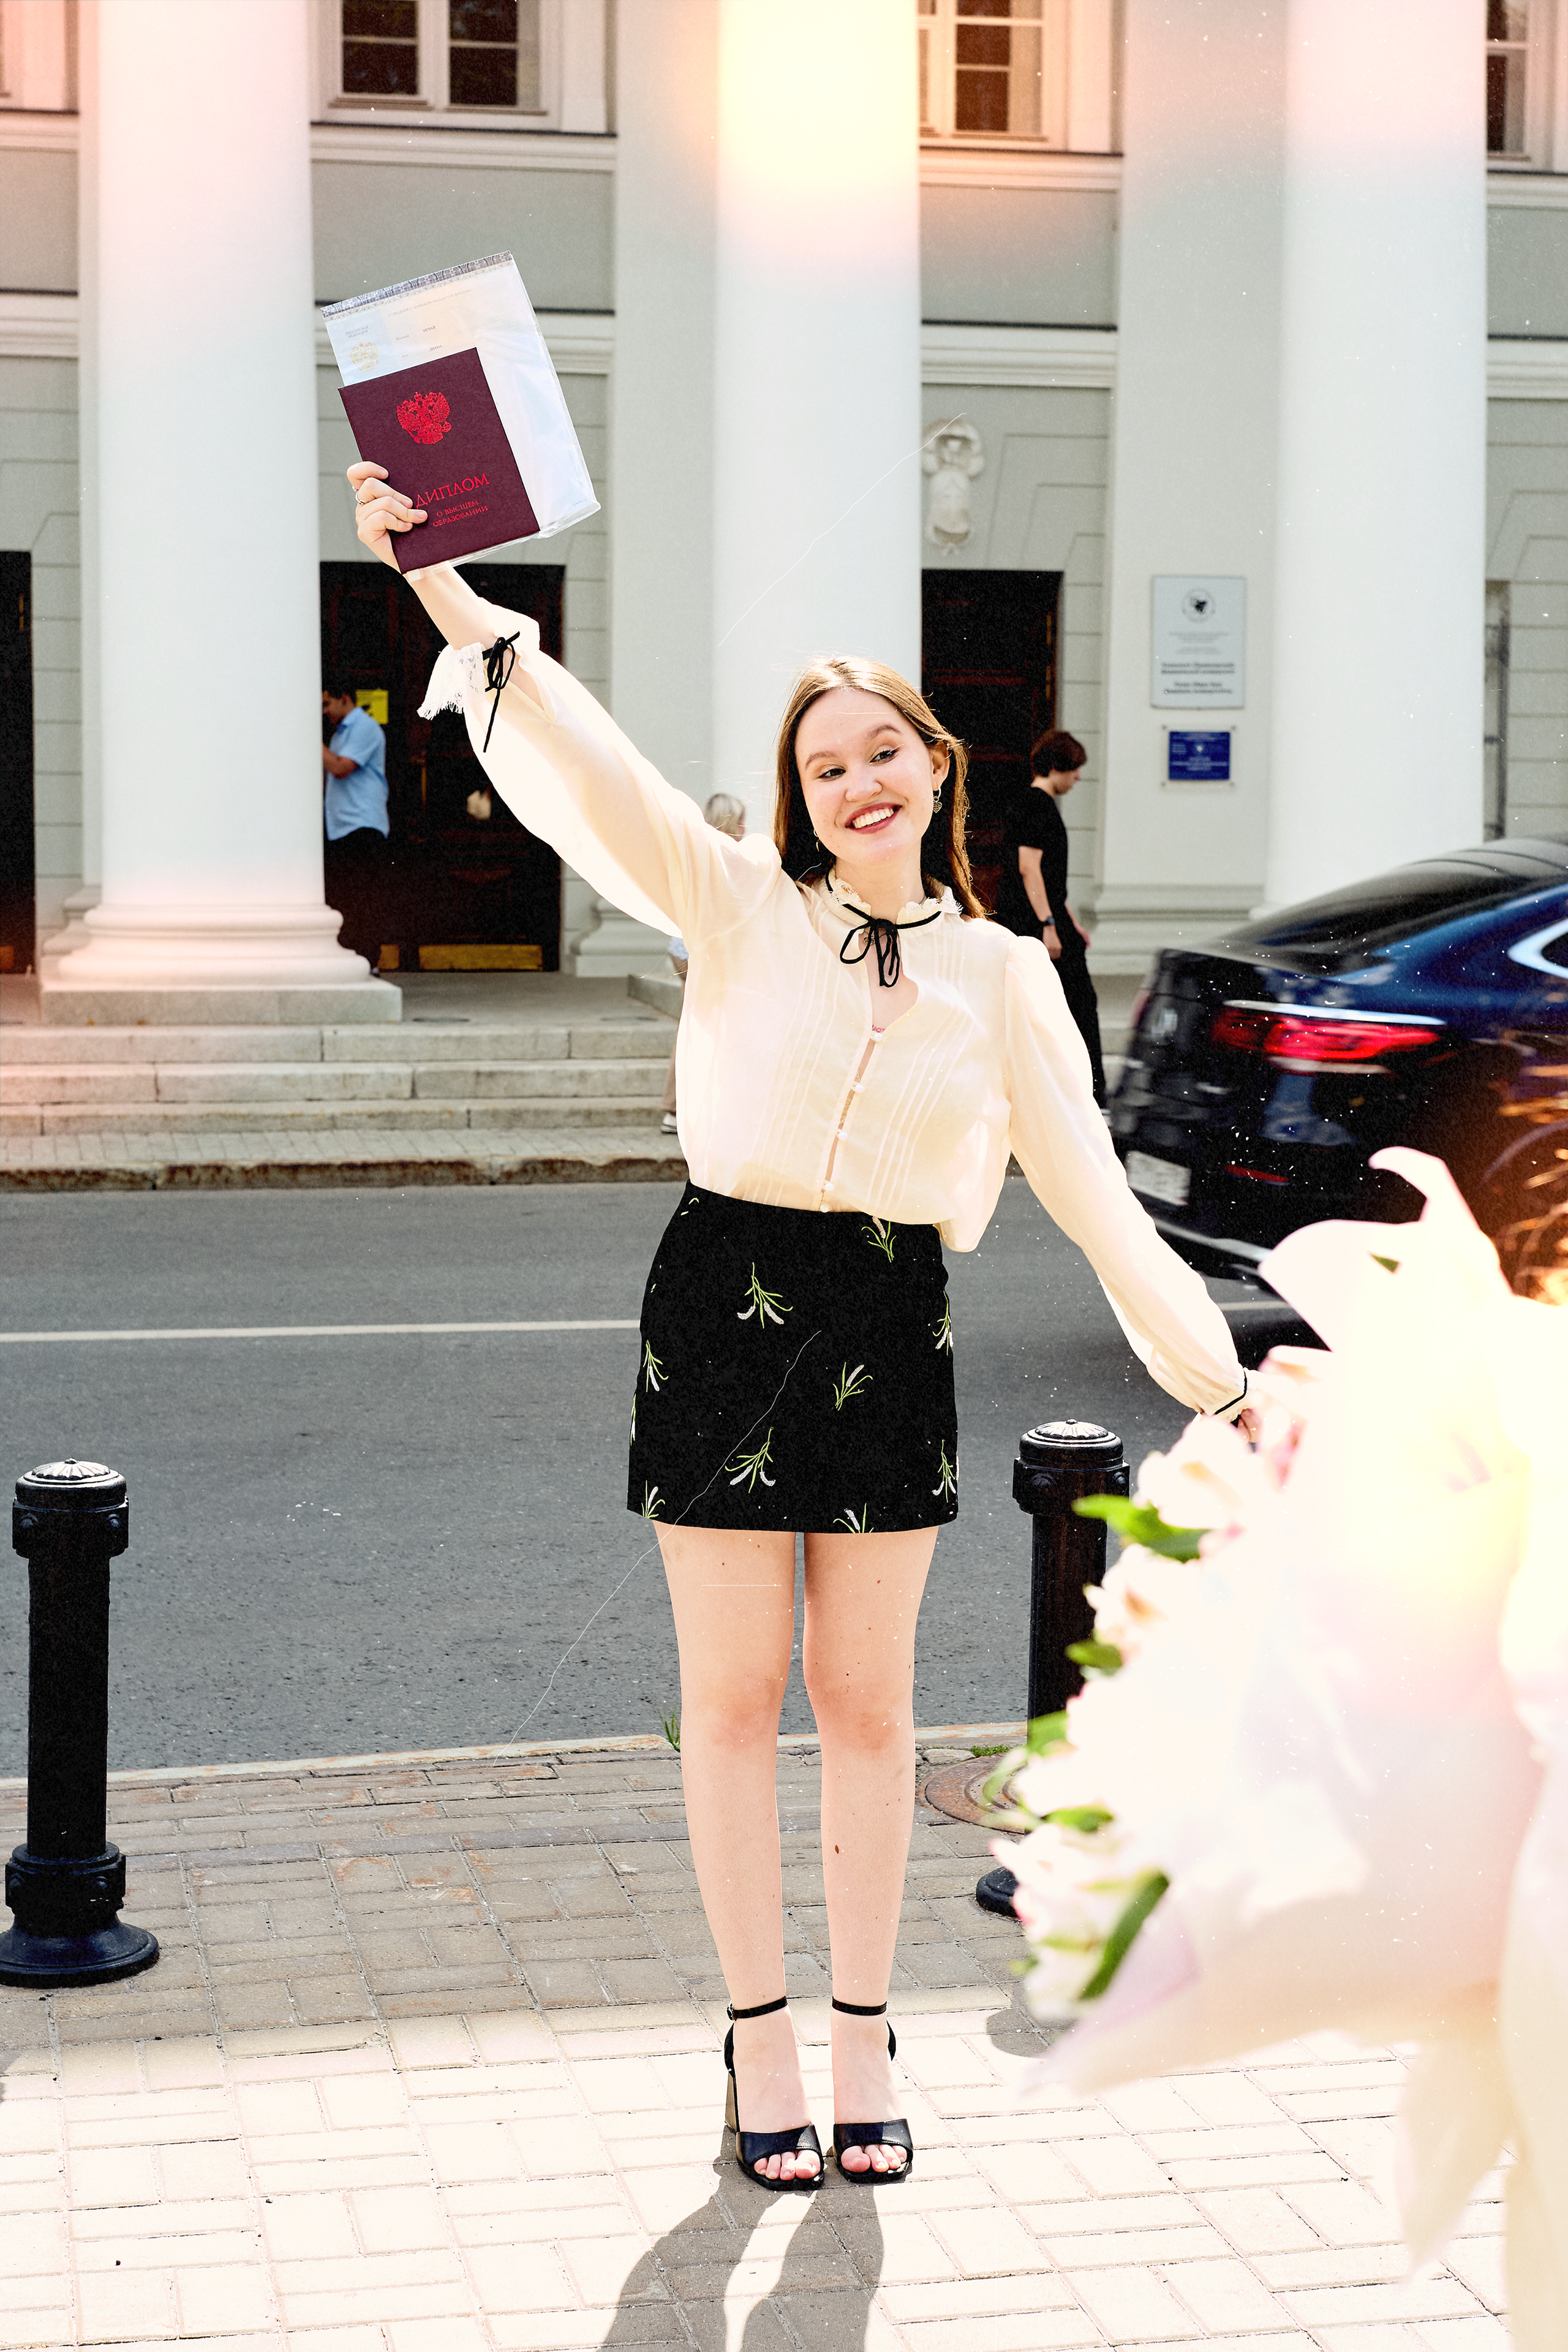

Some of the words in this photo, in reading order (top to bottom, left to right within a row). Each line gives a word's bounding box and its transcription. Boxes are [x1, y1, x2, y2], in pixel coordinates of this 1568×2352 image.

[417, 473, 490, 510] ДИПЛОМ
[432, 505, 489, 527] ОБРАЗОВАНИИ
[445, 500, 479, 515] ВЫСШЕМ
